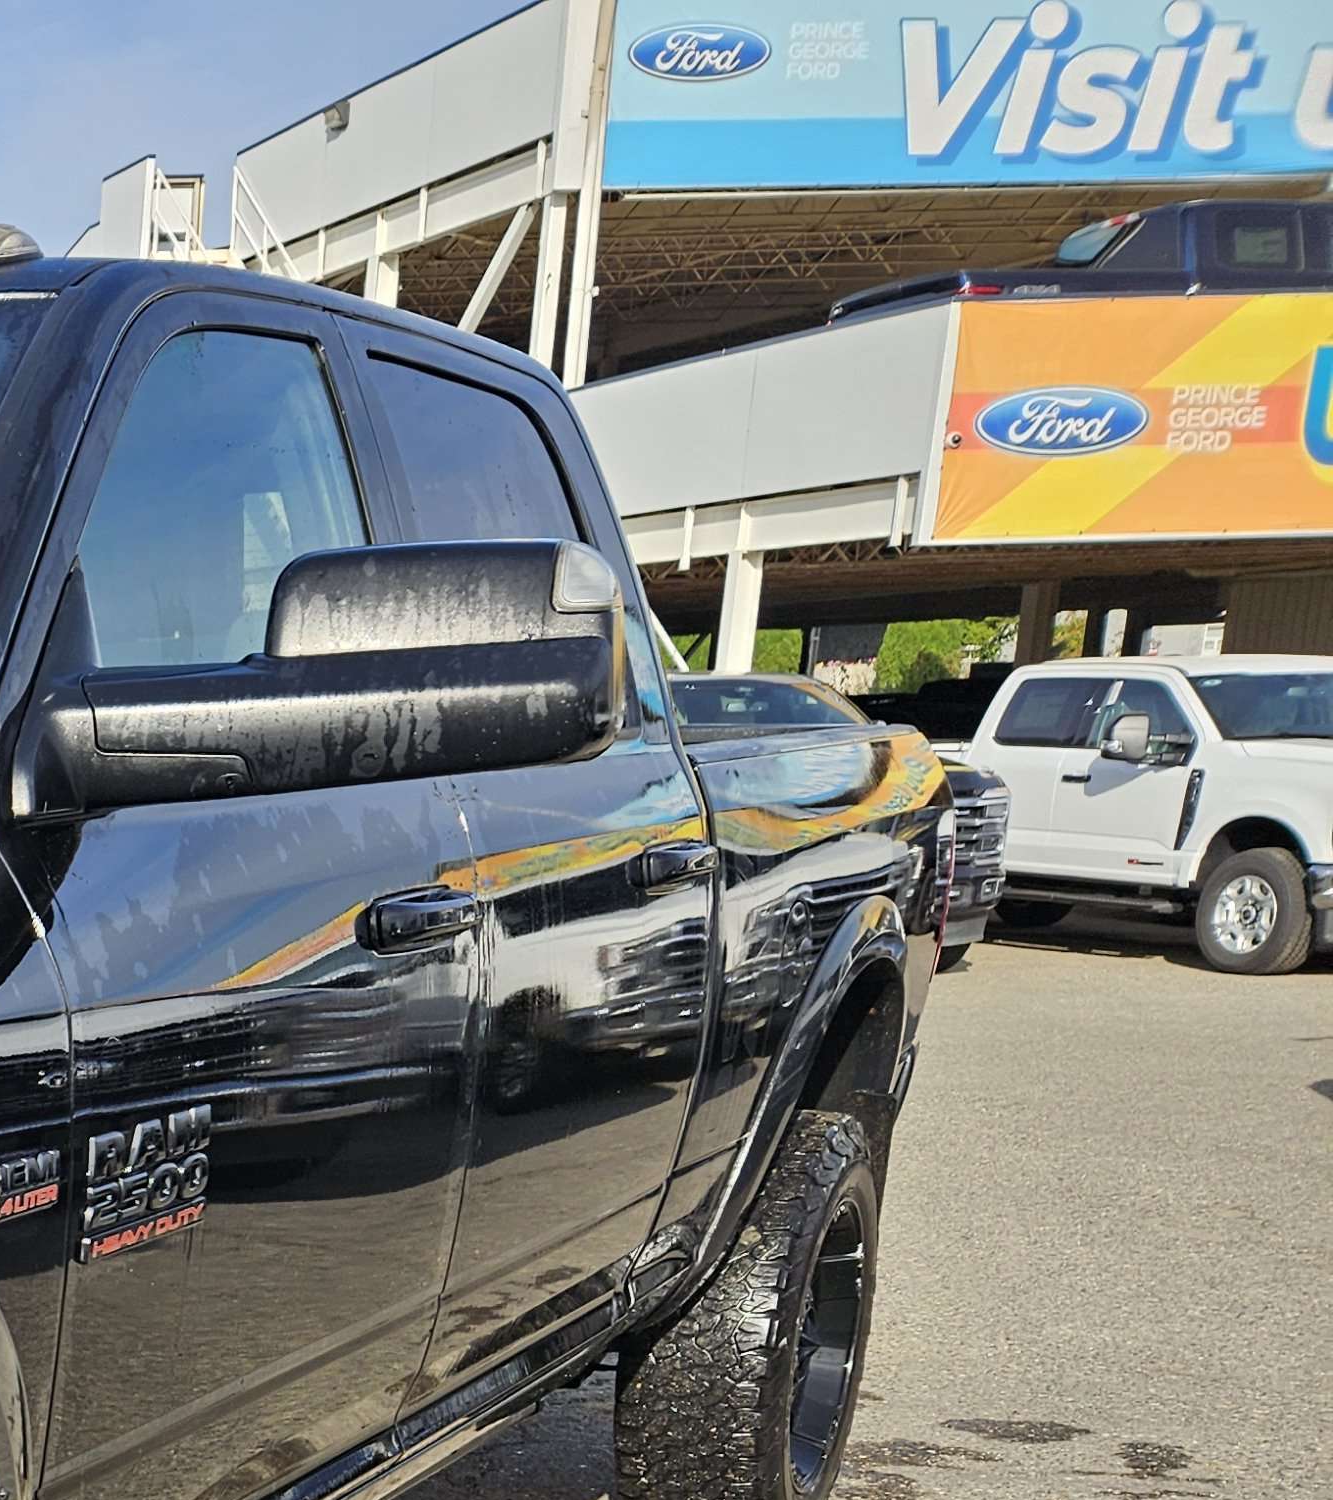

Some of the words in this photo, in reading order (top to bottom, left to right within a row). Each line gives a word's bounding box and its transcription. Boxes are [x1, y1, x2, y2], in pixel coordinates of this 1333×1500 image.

[791, 21, 864, 40] PRINCE
[655, 31, 745, 73] Ford
[789, 41, 869, 59] GEORGE
[786, 62, 841, 80] FORD
[900, 0, 1255, 158] Visit
[1172, 384, 1261, 405] PRINCE
[1008, 395, 1116, 445] Ford
[1169, 406, 1267, 428] GEORGE
[1166, 431, 1231, 452] FORD
[88, 1103, 211, 1181] RAM
[84, 1152, 209, 1232] 2500
[92, 1222, 153, 1258] HEAVY
[155, 1202, 205, 1235] DUTY
